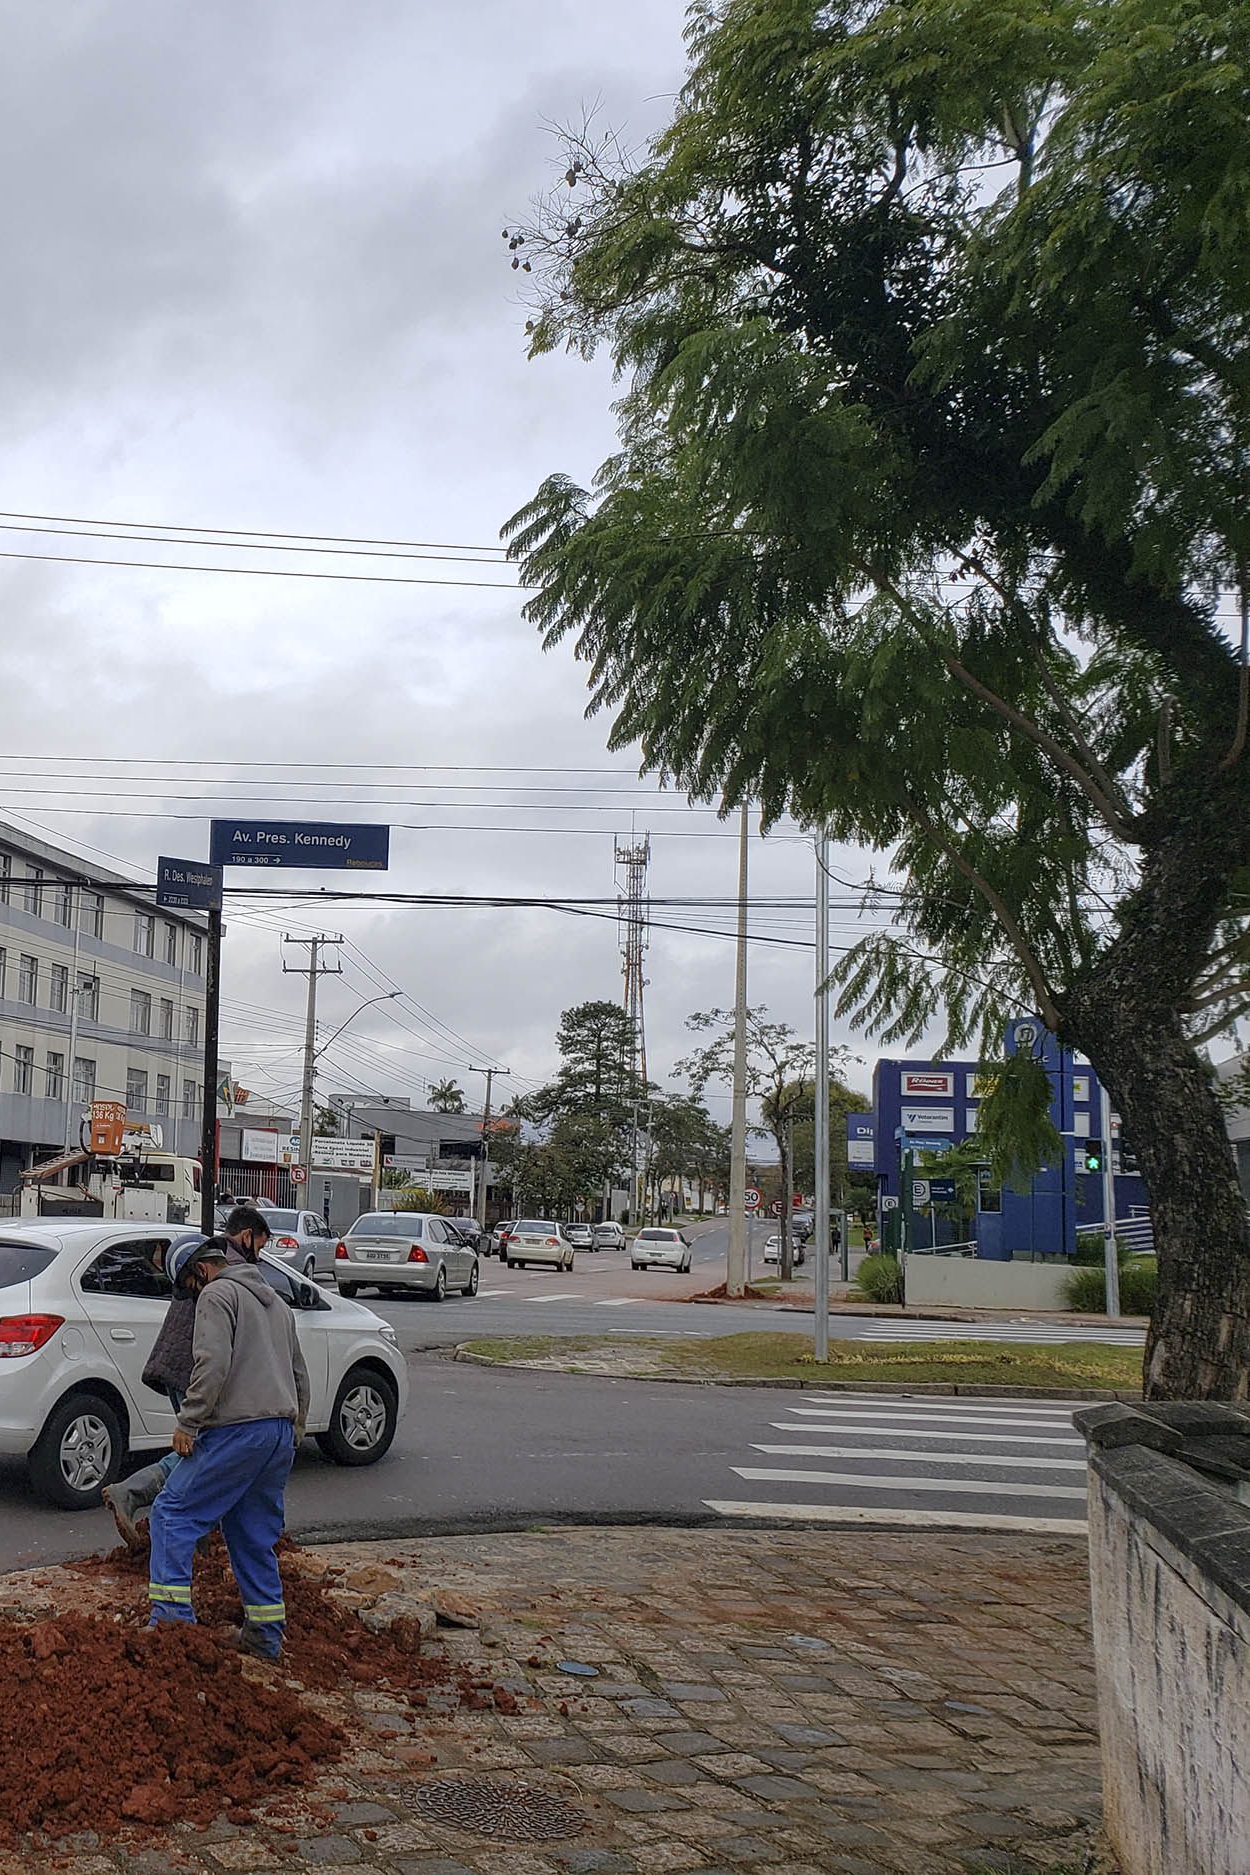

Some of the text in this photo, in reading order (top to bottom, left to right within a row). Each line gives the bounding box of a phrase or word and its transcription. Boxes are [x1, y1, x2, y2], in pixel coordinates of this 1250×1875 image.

[232, 830, 351, 850] Av. Pres. Kennedy
[254, 856, 269, 864] 300
[164, 868, 171, 881] R.
[172, 869, 186, 882] Des.
[92, 1110, 104, 1120] 136
[104, 1110, 115, 1122] Kg
[745, 1191, 759, 1201] 50
